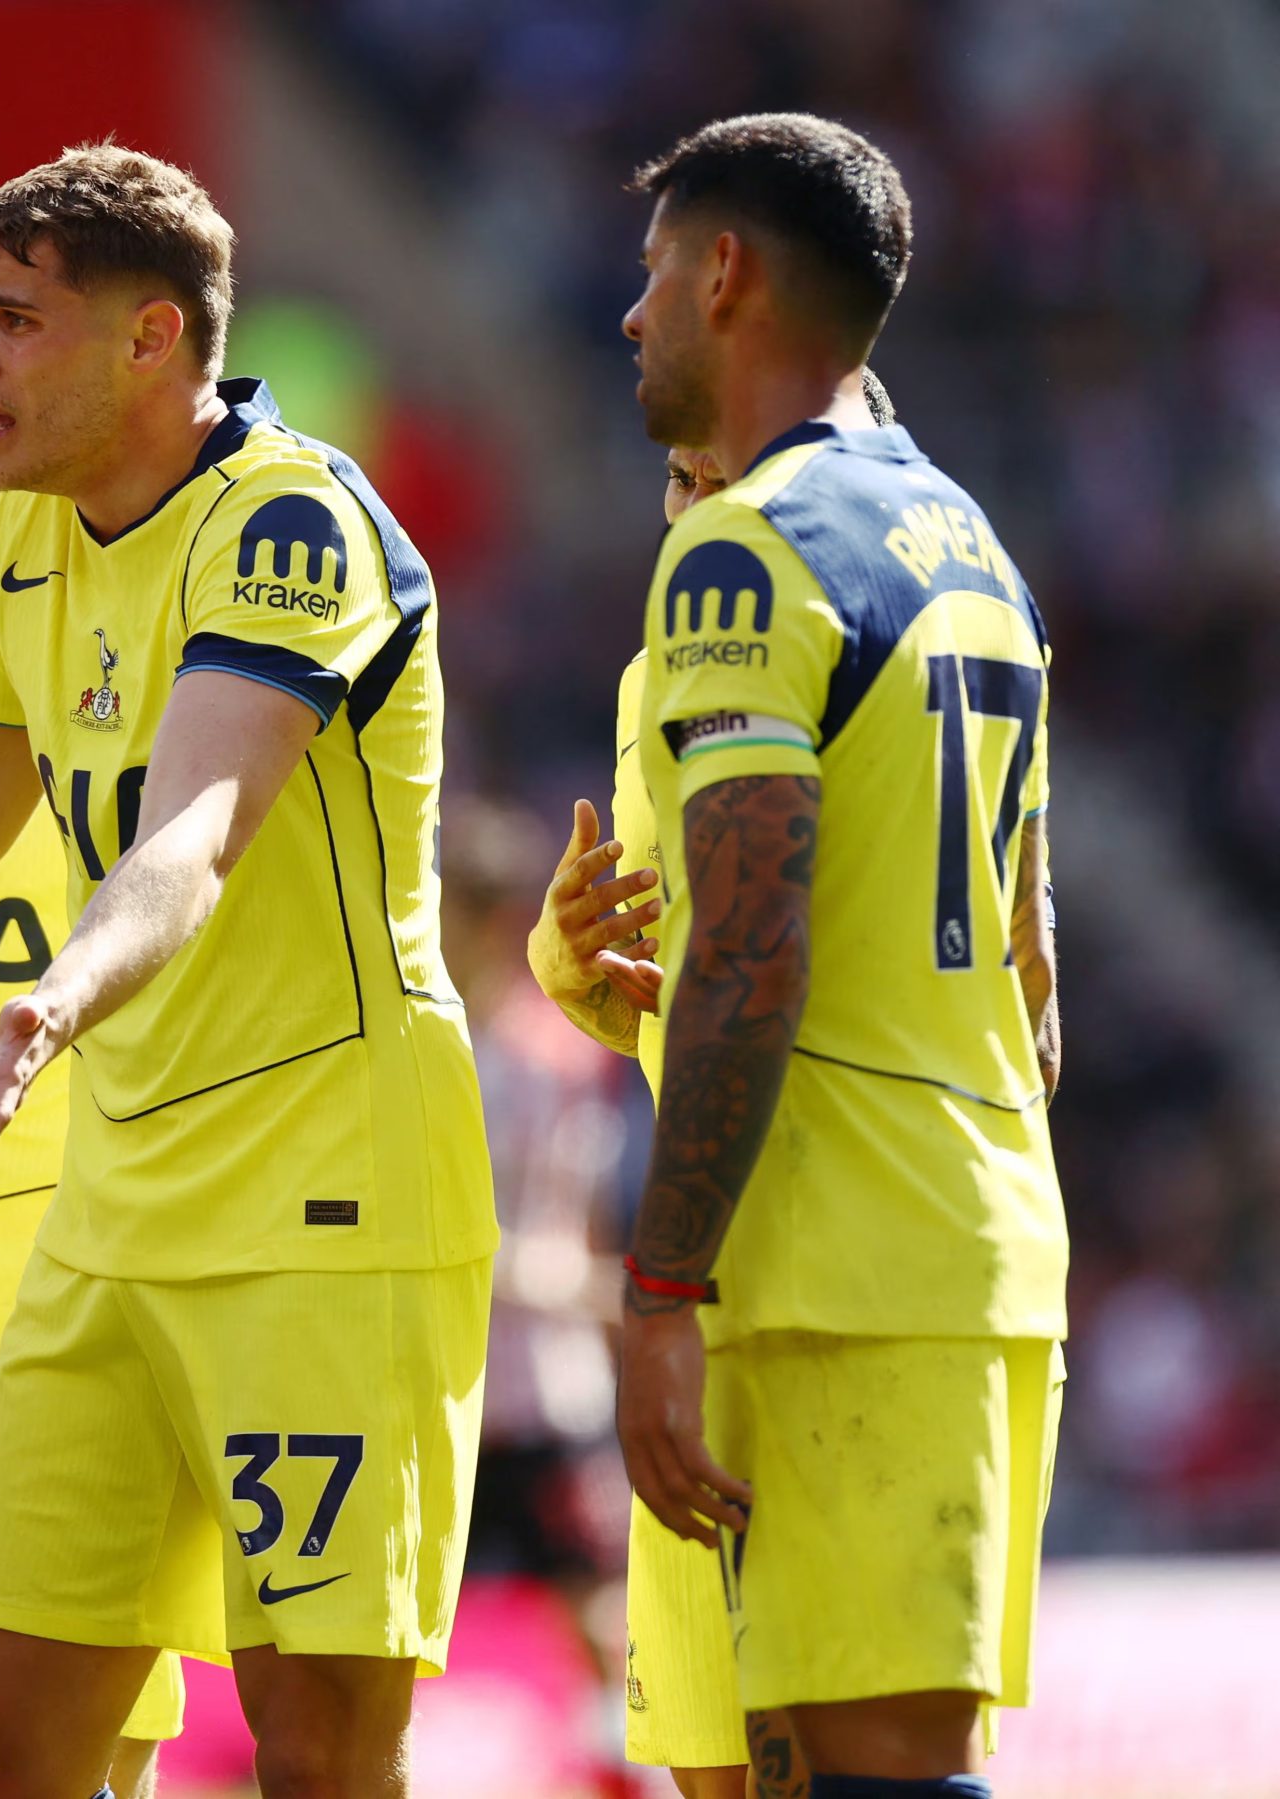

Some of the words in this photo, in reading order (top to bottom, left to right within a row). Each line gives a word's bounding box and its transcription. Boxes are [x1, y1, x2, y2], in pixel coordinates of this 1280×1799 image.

[232, 581, 340, 625] kraken
[664, 640, 769, 674] kraken
[924, 653, 1043, 969] 17
[224, 1432, 365, 1557] 37
